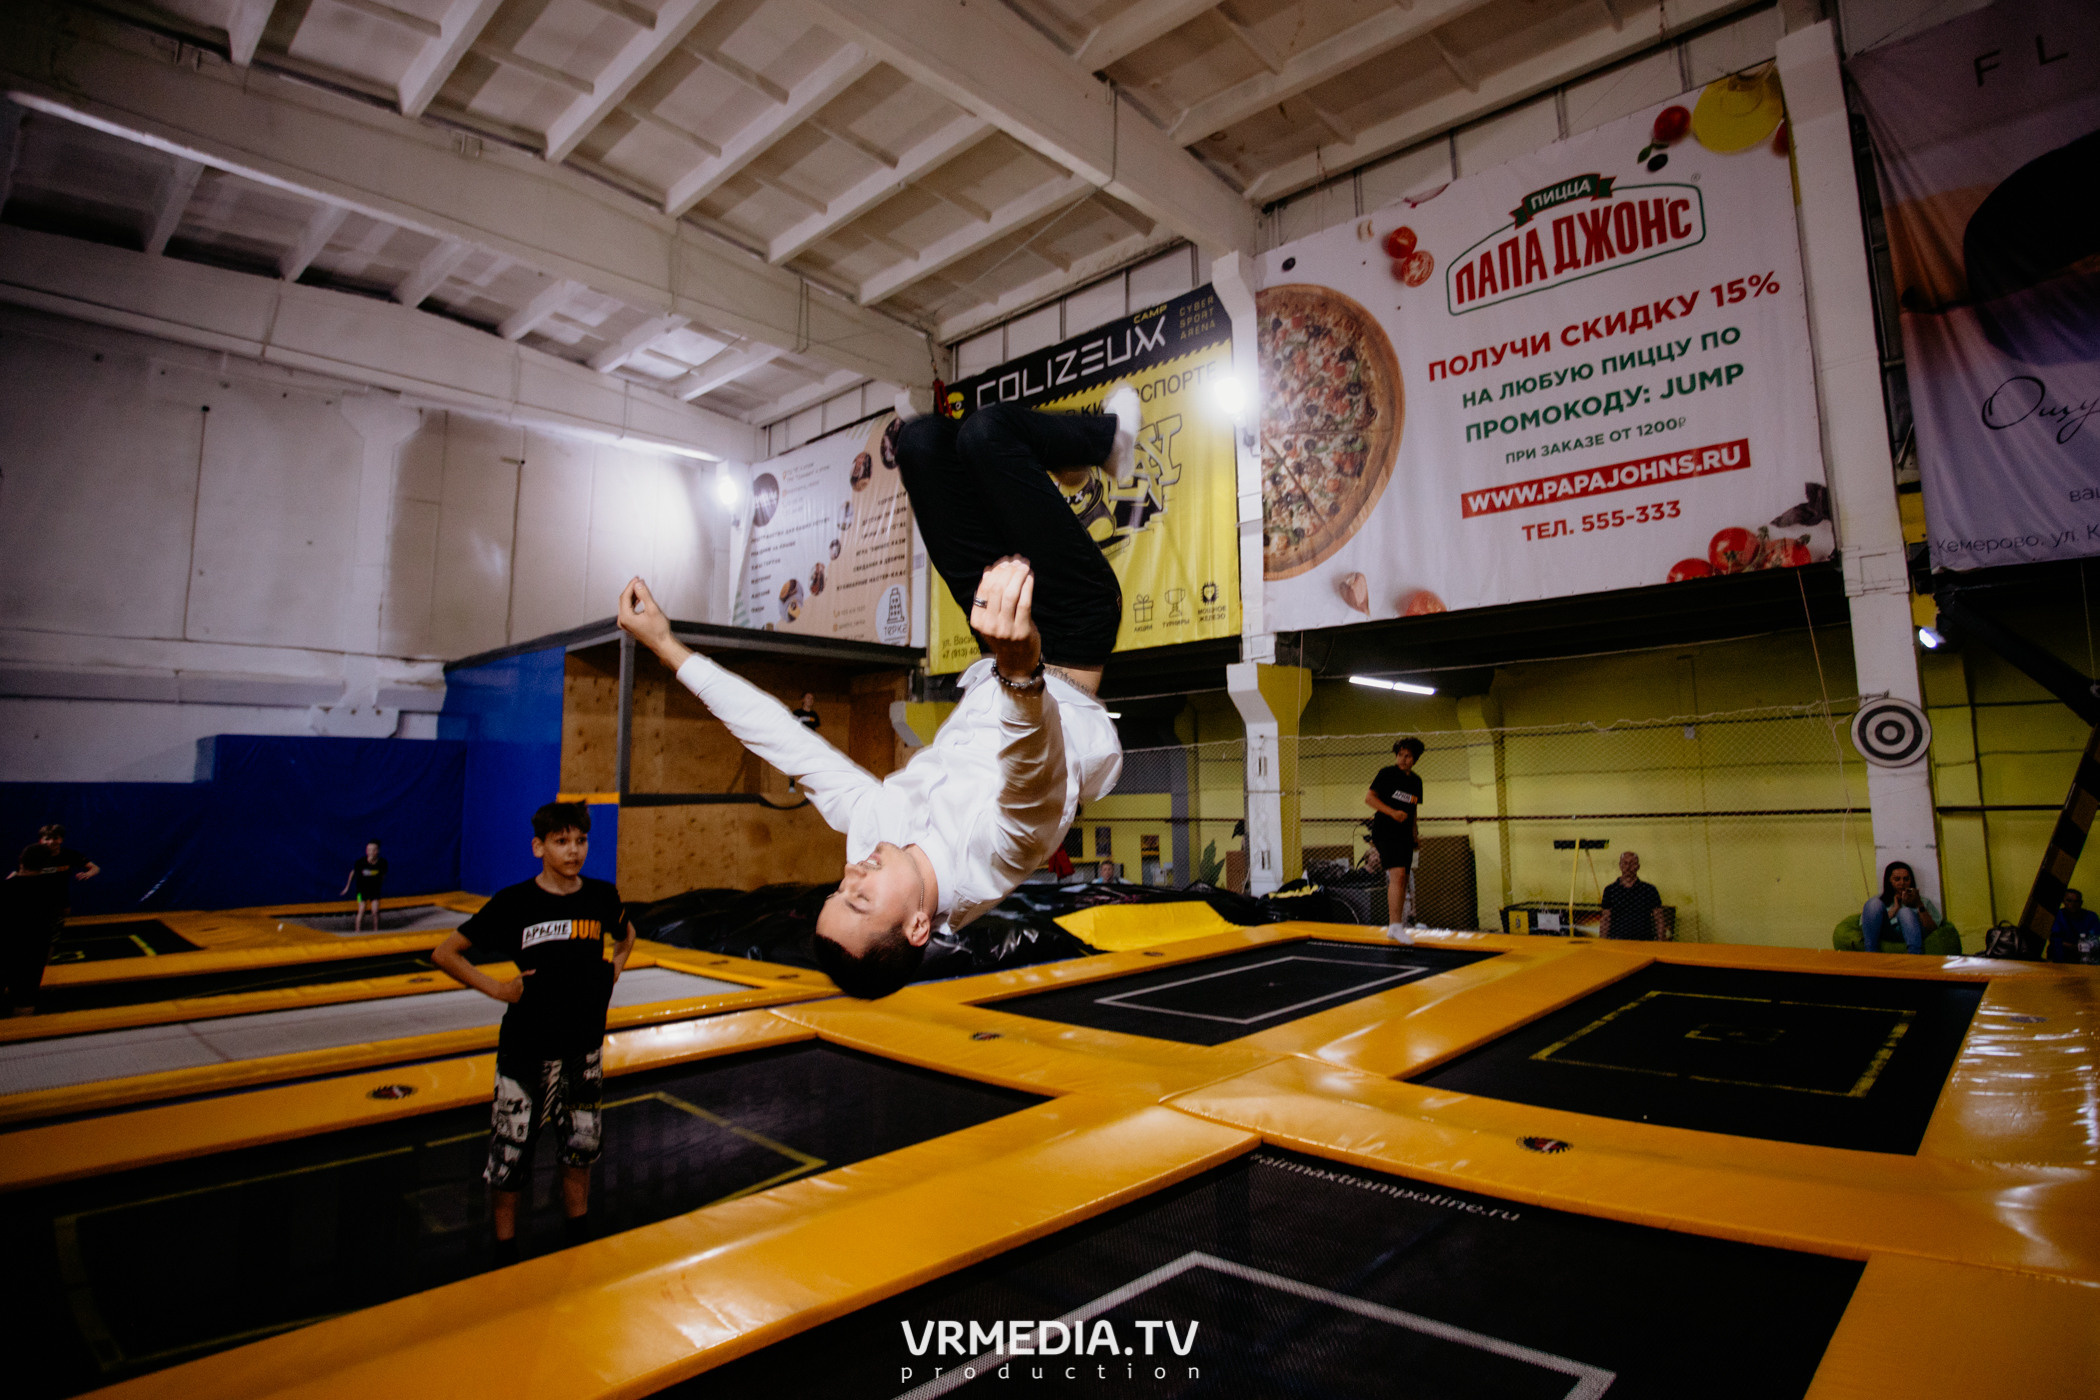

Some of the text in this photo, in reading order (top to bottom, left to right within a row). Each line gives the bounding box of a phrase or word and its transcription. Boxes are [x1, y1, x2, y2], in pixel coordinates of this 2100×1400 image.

[1530, 179, 1592, 210] ПИЦЦА
[1455, 227, 1548, 305] ПАПА
[1133, 303, 1168, 324] CAMP
[1179, 295, 1214, 317] CYBER
[1179, 307, 1214, 329] SPORT
[1180, 319, 1216, 341] ARENA
[1429, 271, 1780, 382] ПОЛУЧИ СКИДКУ 15%
[1462, 327, 1741, 409] НА ЛЮБУЮ ПИЦЦУ ПО
[1466, 363, 1744, 443] ПРОМОКОДУ: JUMP
[1505, 448, 1537, 465] ПРИ
[1541, 433, 1604, 457] ЗАКАЗЕ
[1609, 427, 1632, 442] ОТ
[1467, 444, 1741, 514] WWW.PAPAJOHNS.RU
[1522, 500, 1682, 542] ТЕЛ. 555-333
[2051, 531, 2080, 548] ул.
[525, 920, 569, 943] APACHE
